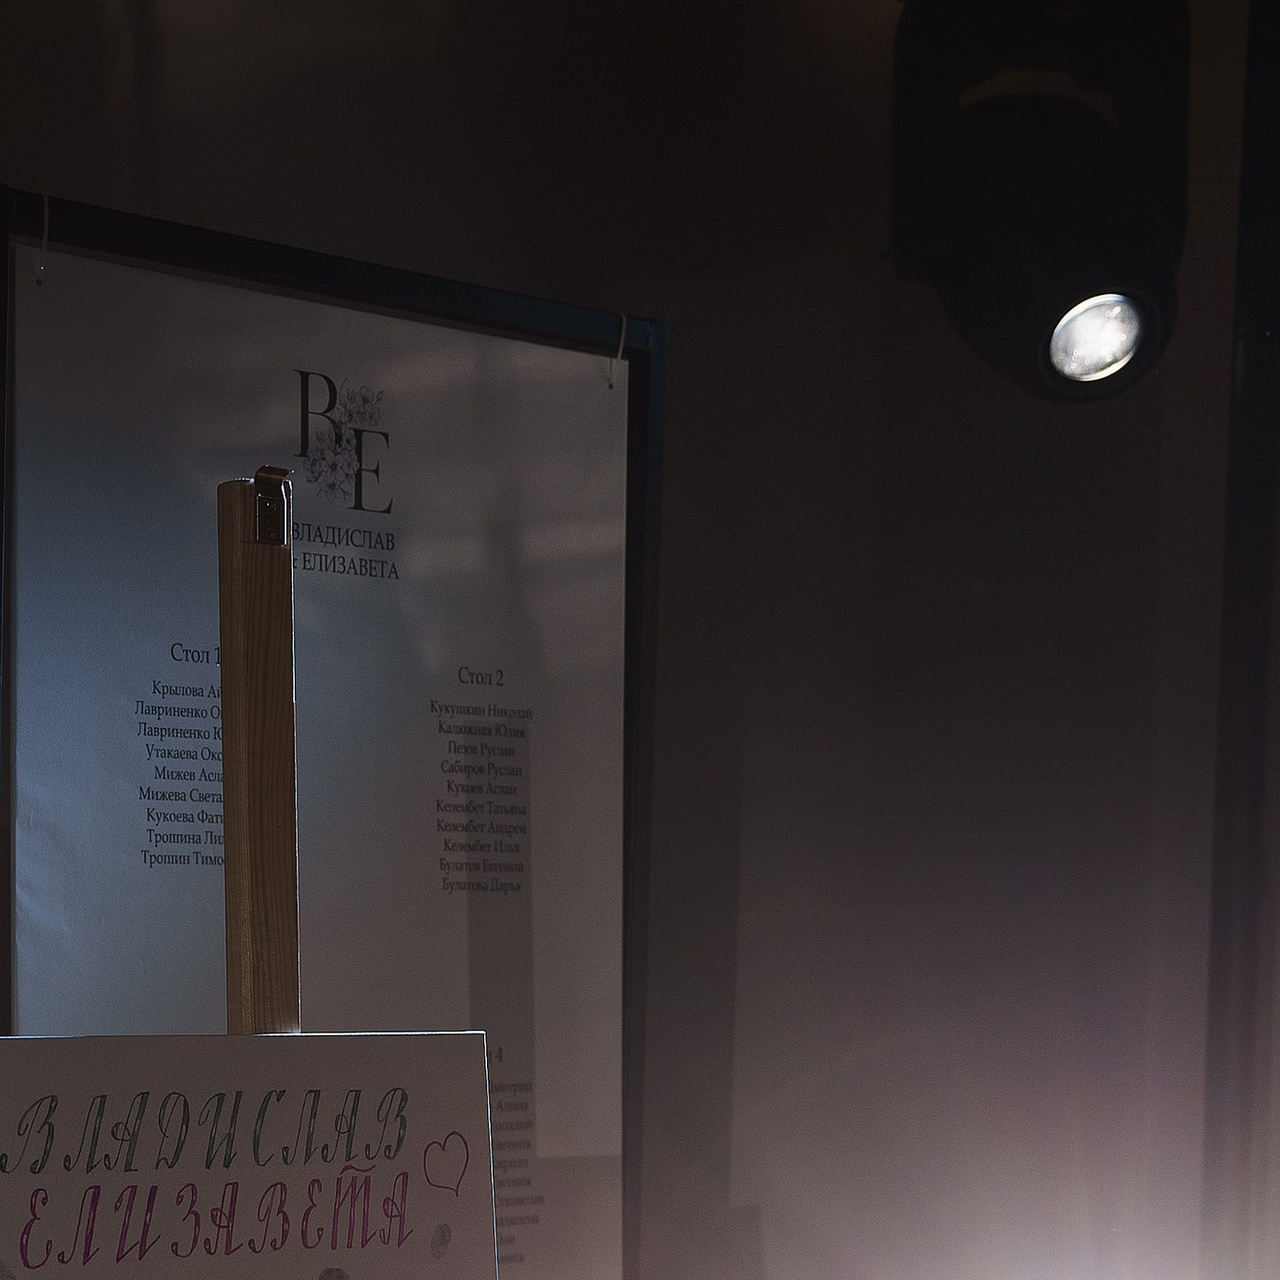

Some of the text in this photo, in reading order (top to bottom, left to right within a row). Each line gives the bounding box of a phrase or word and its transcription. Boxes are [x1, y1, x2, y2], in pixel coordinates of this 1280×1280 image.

[292, 522, 396, 551] ВЛАДИСЛАВ
[302, 552, 400, 580] ЕЛИЗАВЕТА
[171, 643, 210, 664] Стол
[458, 666, 505, 687] Стол 2
[152, 680, 204, 698] Крылова
[135, 700, 208, 721] Лавриненко
[430, 699, 533, 720] Кукушкин Николай
[137, 722, 210, 742] Лавриненко
[145, 744, 198, 762] Утакаева
[480, 743, 516, 759] Руслан
[154, 766, 196, 781] Мижев
[487, 762, 523, 780] Руслан
[139, 787, 187, 802] Мижева
[146, 807, 195, 826] Кукоева
[0, 1087, 410, 1176] ВЛАДИСЛАВ
[20, 1164, 415, 1270] ЕЛИЗАВЕТА
